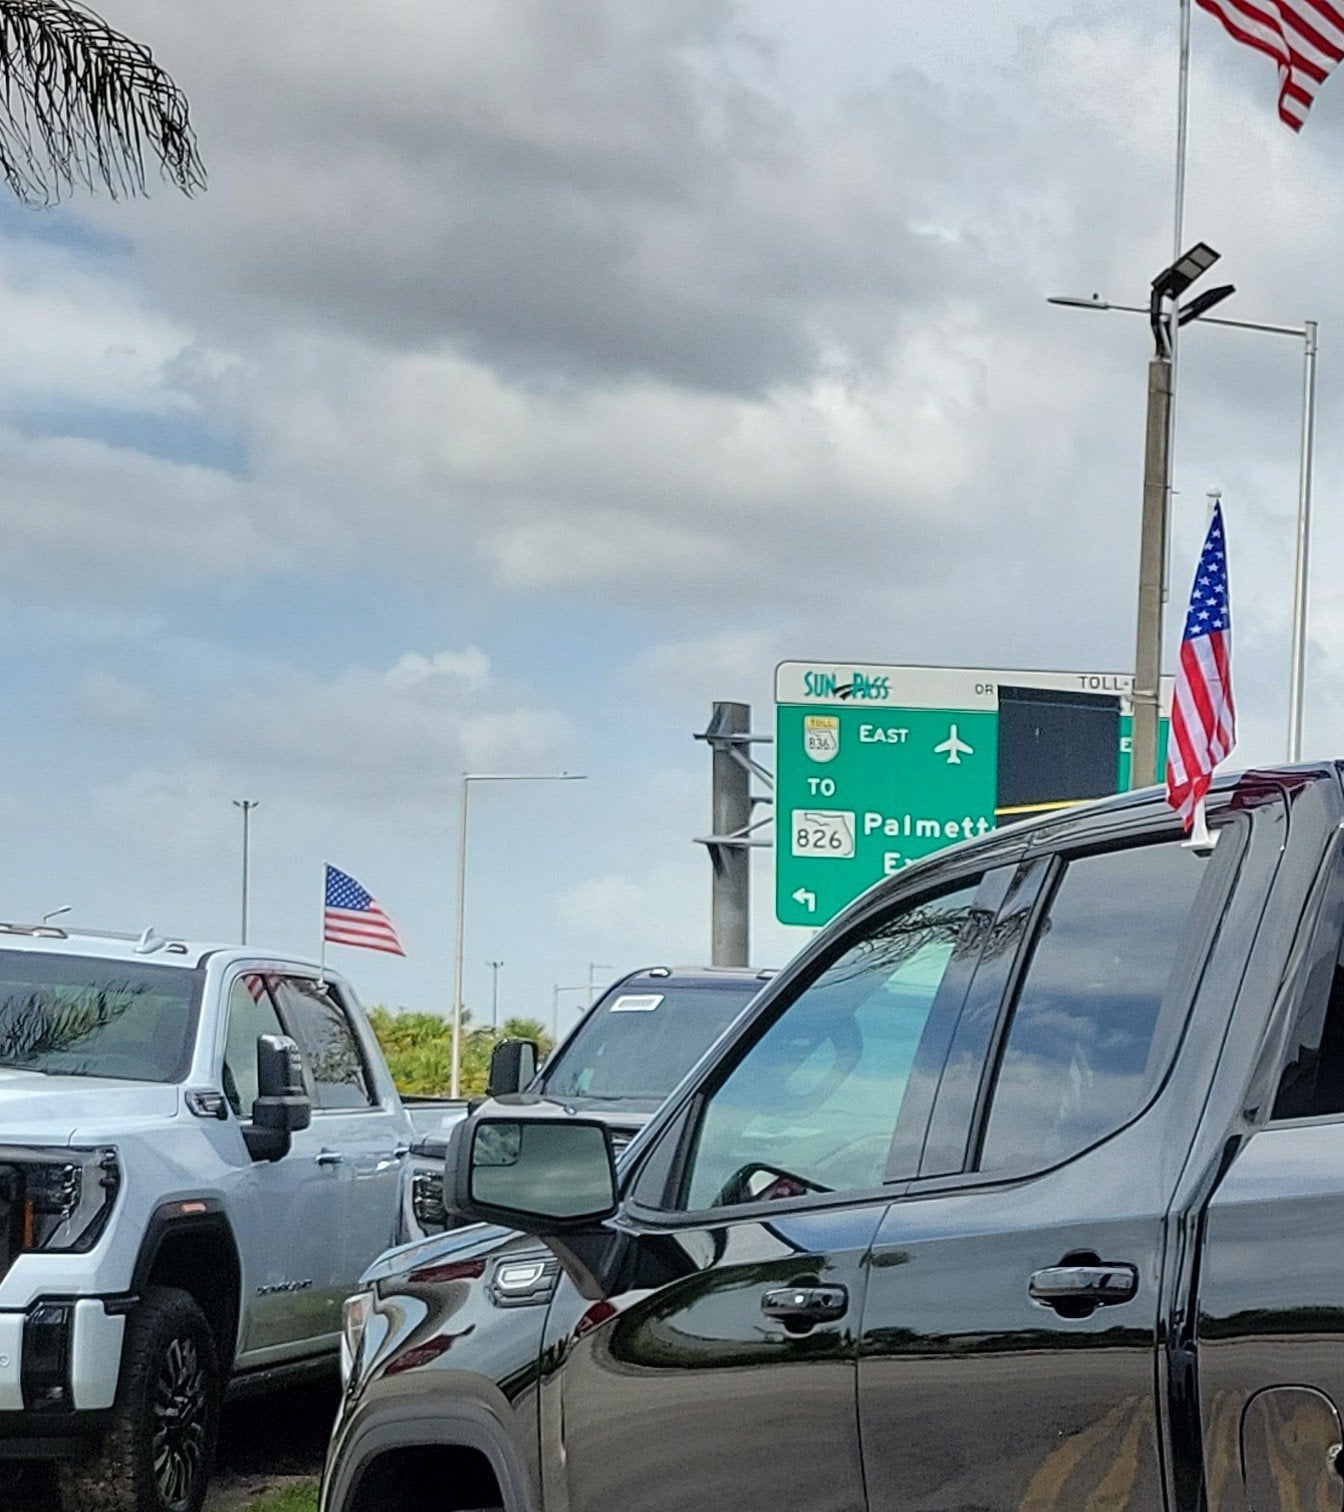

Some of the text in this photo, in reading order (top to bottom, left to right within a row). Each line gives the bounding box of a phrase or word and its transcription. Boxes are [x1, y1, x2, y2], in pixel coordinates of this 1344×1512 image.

[974, 676, 1136, 695] OR TOLL-
[859, 724, 909, 743] EAST
[807, 778, 835, 797] TO
[796, 812, 996, 849] 826 Palmett
